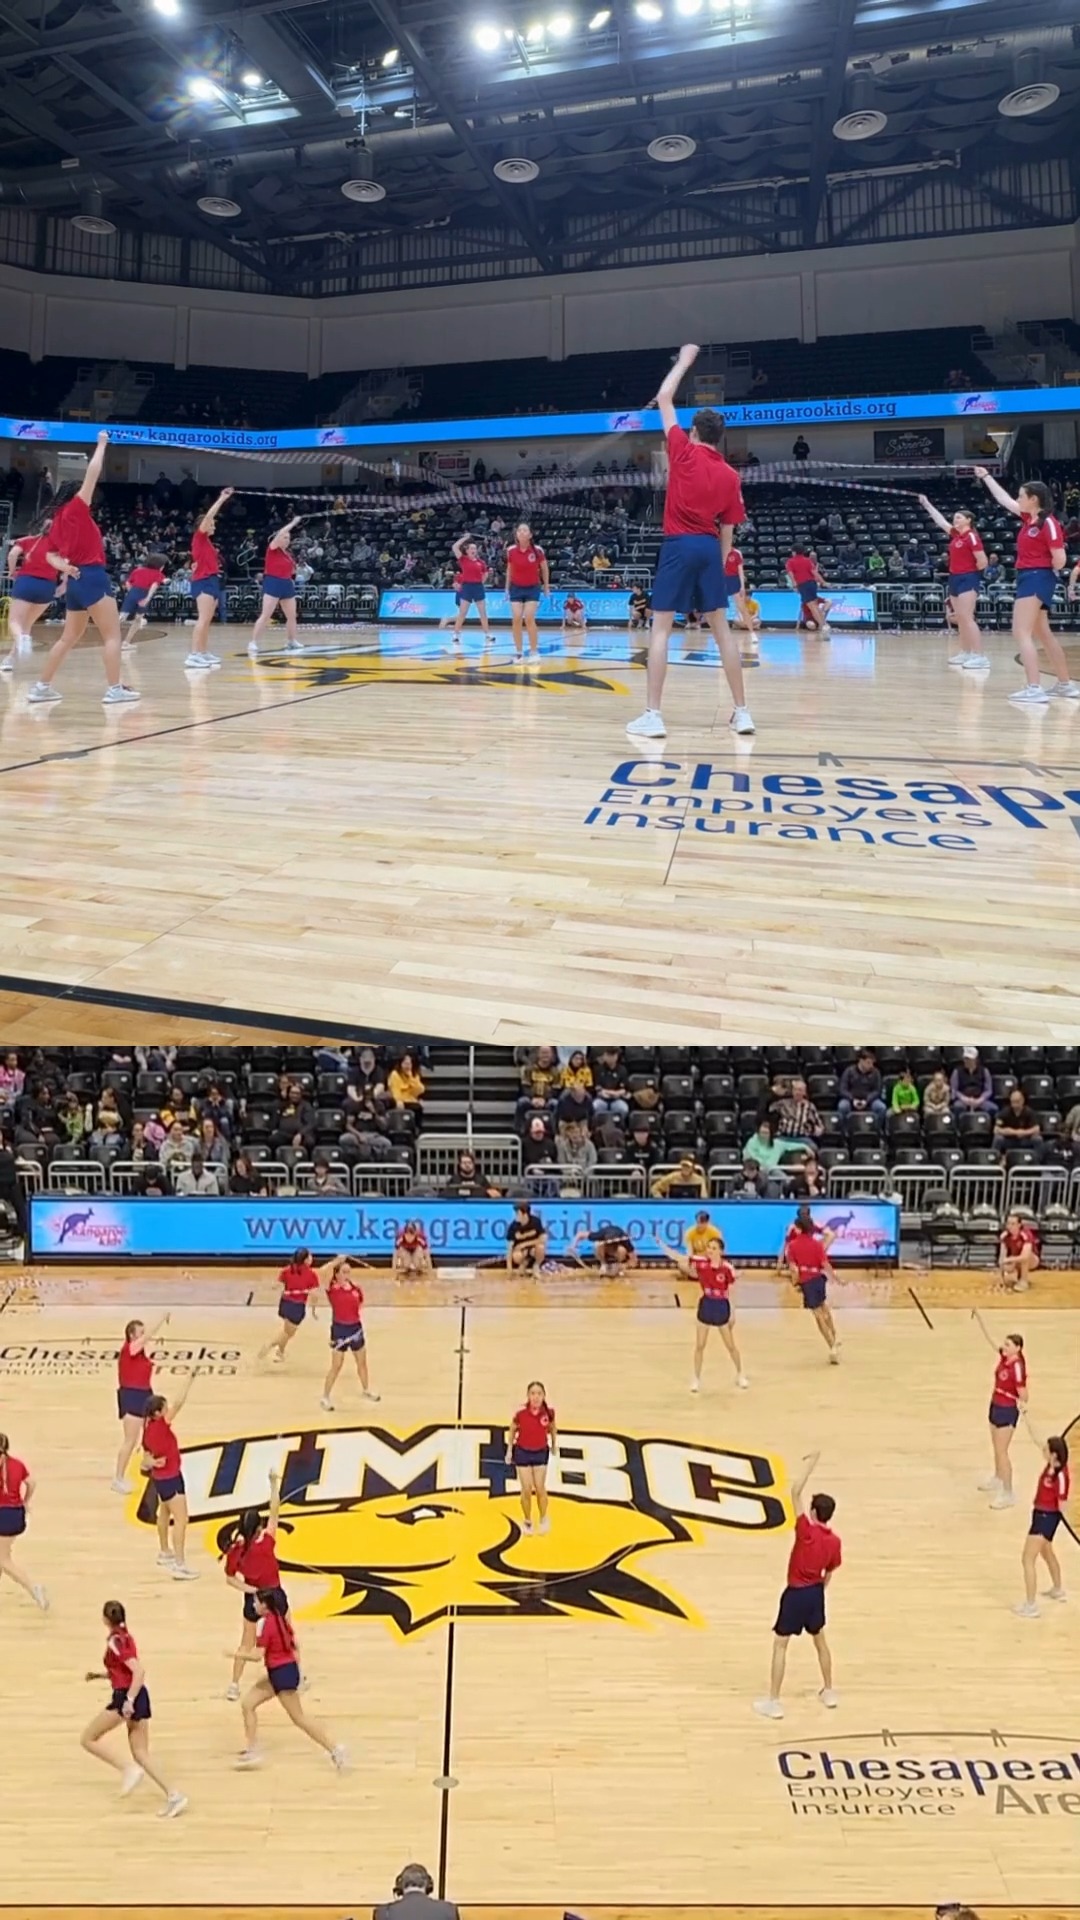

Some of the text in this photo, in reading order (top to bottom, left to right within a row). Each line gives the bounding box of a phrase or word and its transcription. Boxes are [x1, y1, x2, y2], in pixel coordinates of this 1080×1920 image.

[722, 401, 898, 423] w.kangarookids.org
[610, 759, 1080, 829] Chesap
[600, 788, 993, 827] Employers
[583, 806, 978, 851] Insurance
[0, 1346, 241, 1361] Chesaeake
[152, 1362, 238, 1377] rena
[138, 1425, 786, 1530] UMBC
[787, 1782, 965, 1801] Employers
[791, 1800, 956, 1816] Insurance
